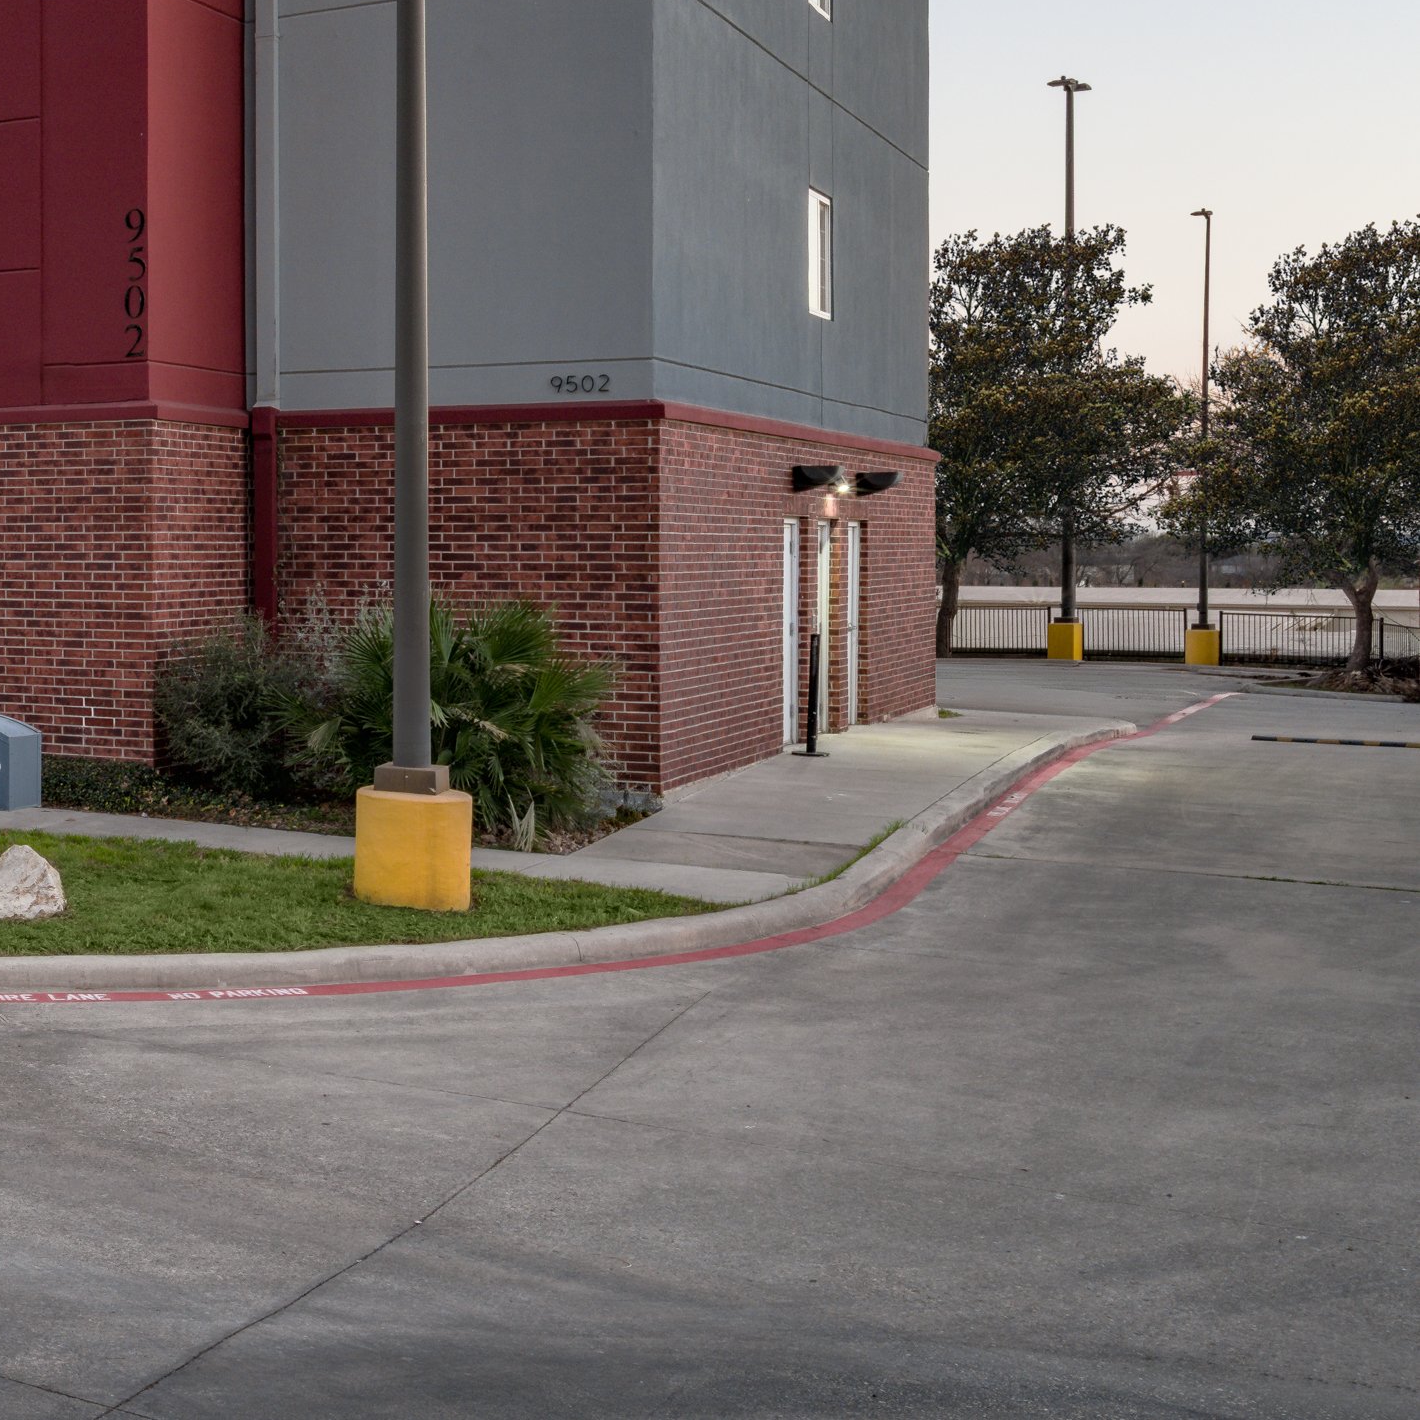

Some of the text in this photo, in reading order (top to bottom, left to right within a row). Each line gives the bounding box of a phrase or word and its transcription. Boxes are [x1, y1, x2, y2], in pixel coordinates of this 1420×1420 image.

[124, 208, 146, 358] 9502
[550, 374, 610, 393] 9502
[48, 993, 112, 1001] LANE
[167, 992, 202, 1000] NO
[208, 987, 309, 998] PARKING
